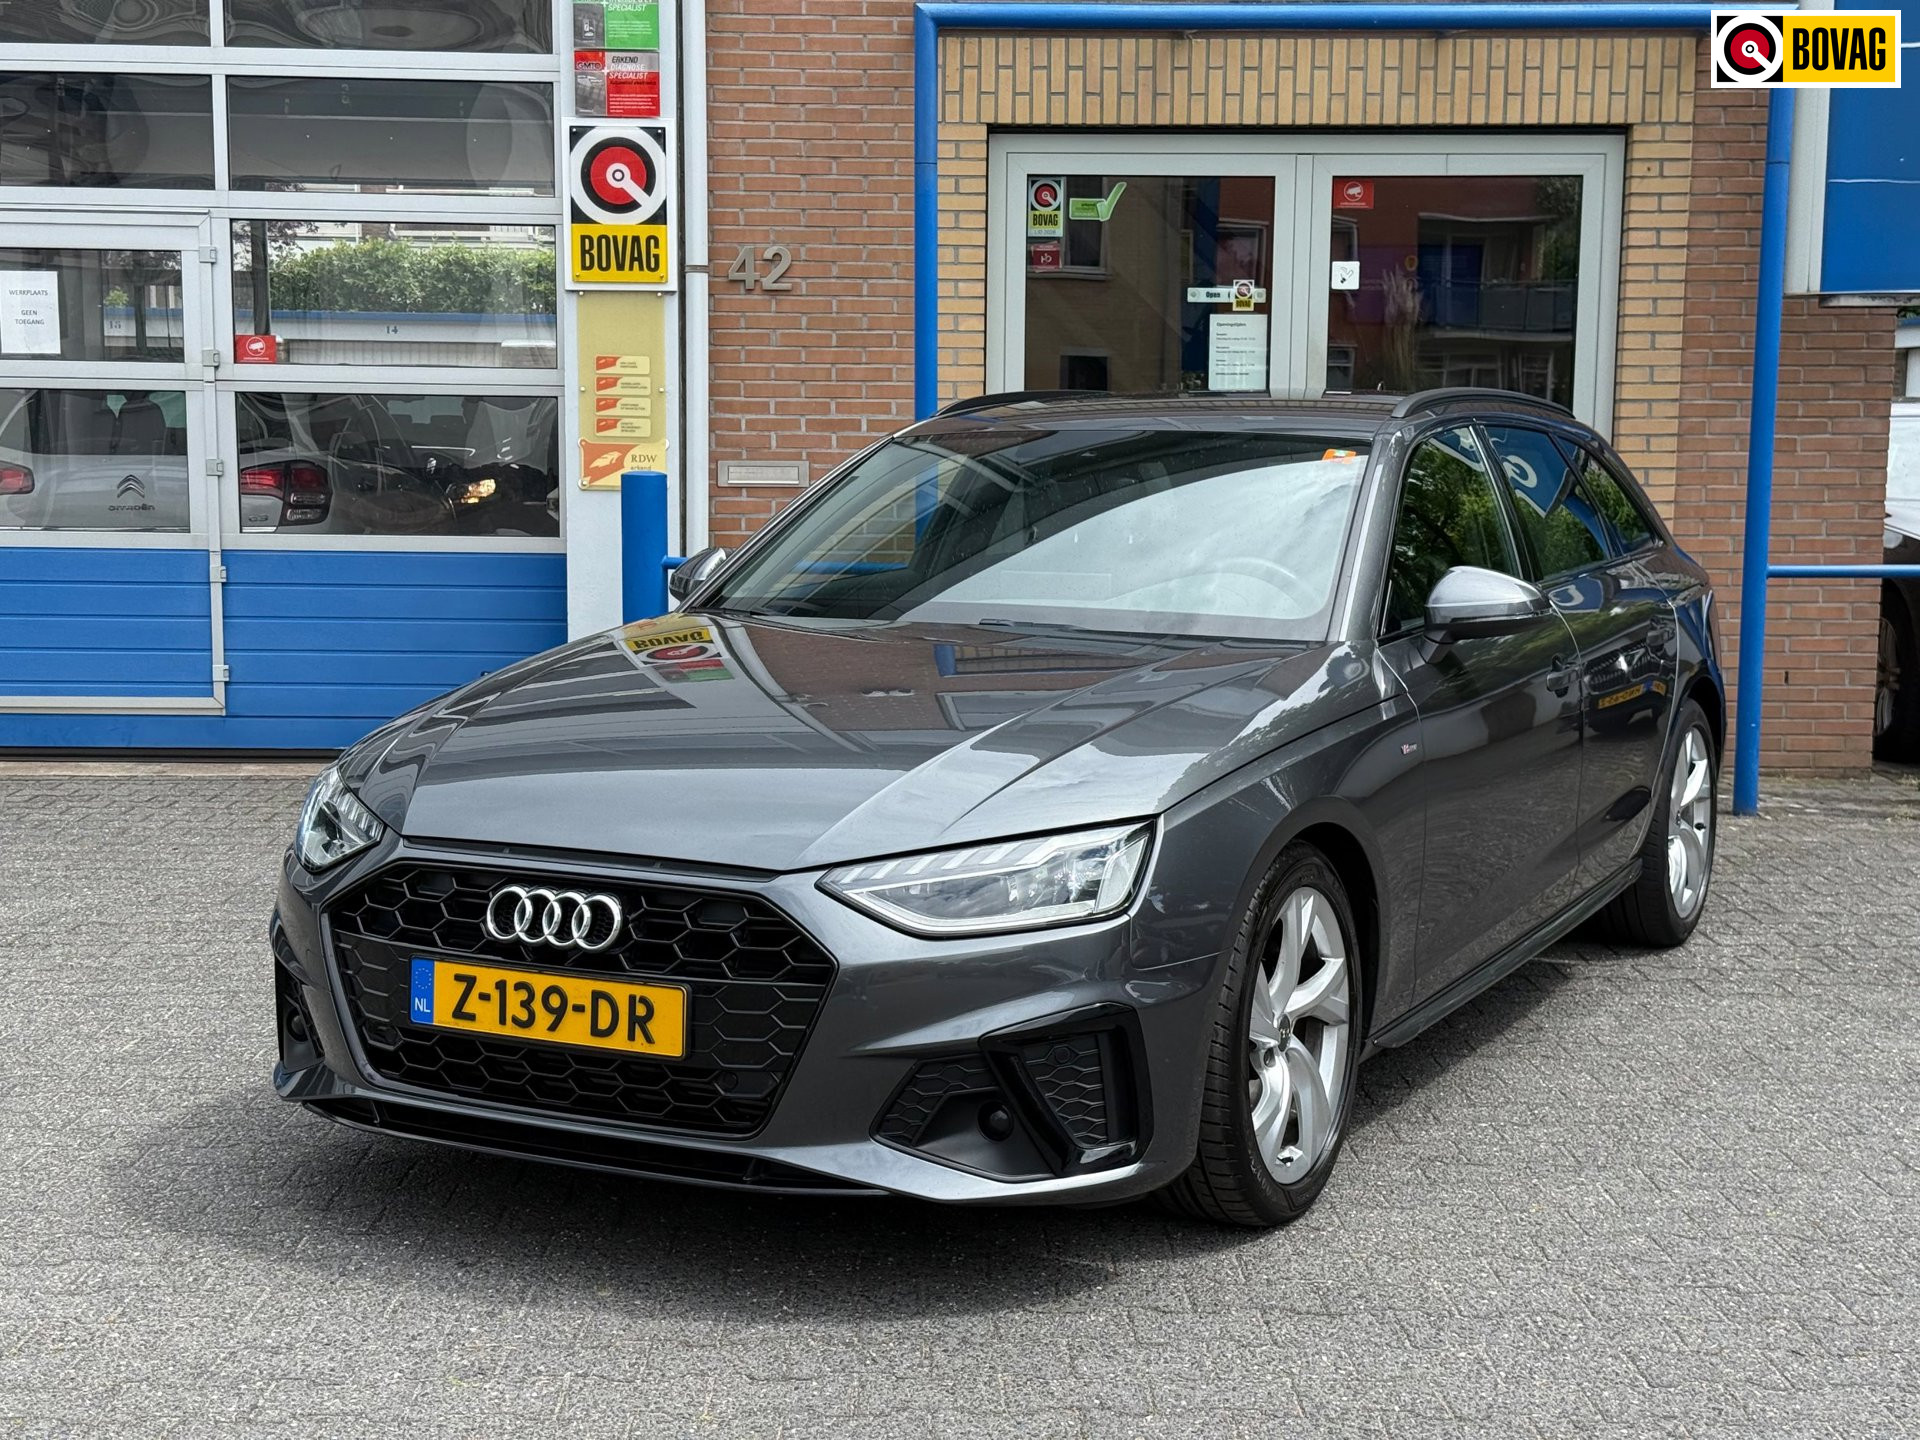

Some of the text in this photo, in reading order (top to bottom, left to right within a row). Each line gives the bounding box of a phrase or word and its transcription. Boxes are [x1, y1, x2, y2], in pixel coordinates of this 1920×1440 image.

[1032, 213, 1058, 226] BOVAG
[580, 234, 660, 272] BOVAG
[728, 245, 793, 290] 42
[1205, 291, 1221, 299] Open
[631, 454, 657, 463] RDW
[414, 997, 431, 1013] NL
[451, 972, 656, 1045] Z-139-DR
